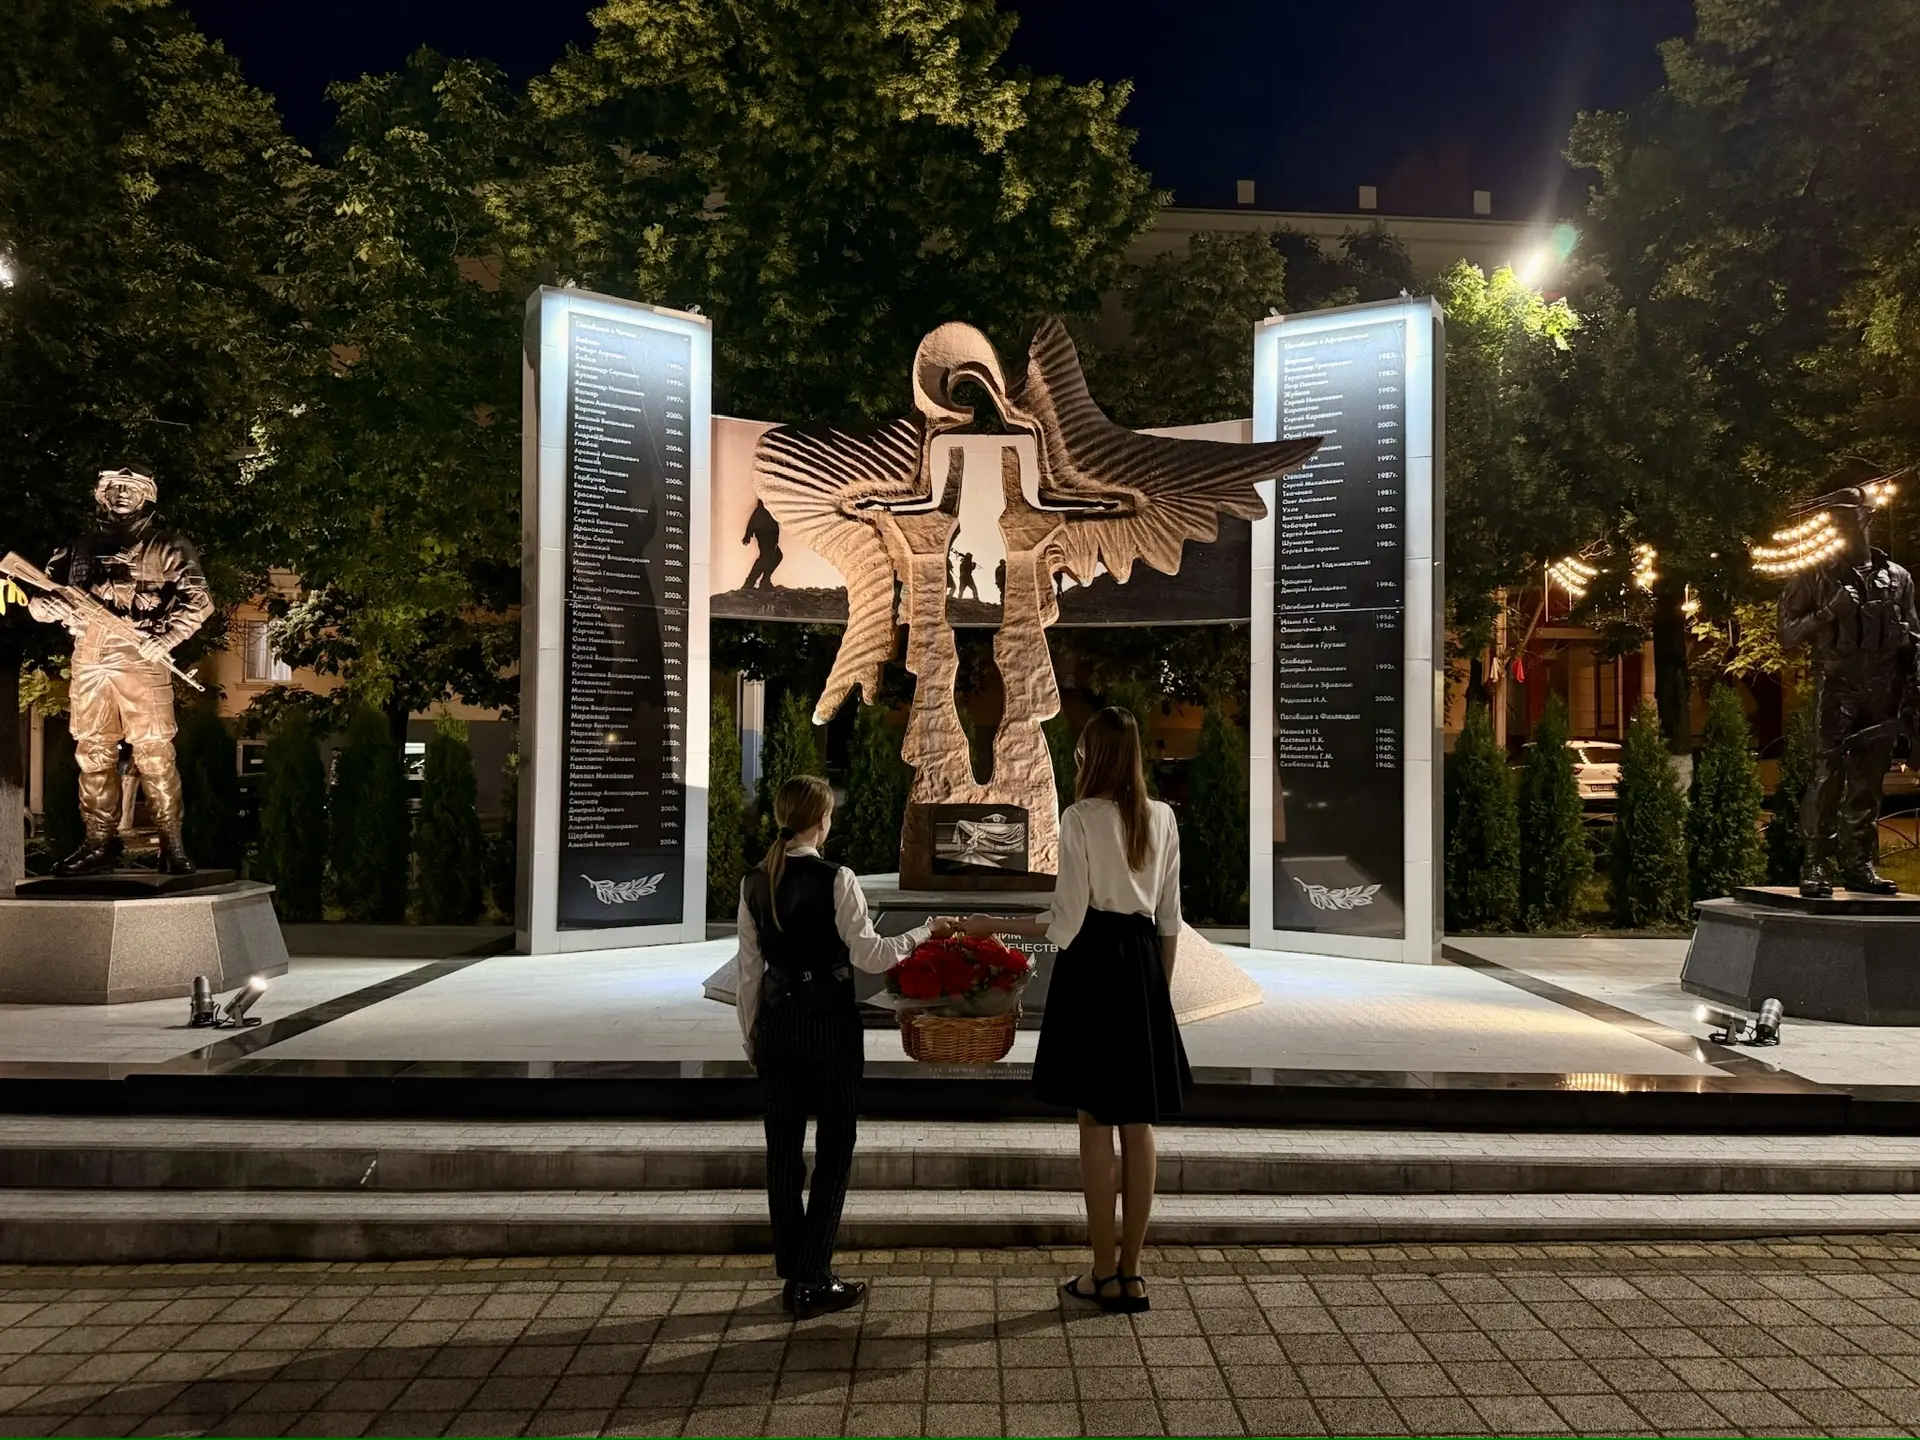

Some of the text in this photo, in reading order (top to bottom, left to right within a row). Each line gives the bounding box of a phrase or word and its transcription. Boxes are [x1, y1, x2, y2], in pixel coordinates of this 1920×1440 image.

[574, 380, 608, 391] Александр
[1283, 415, 1305, 423] Сергей
[1282, 481, 1304, 489] Сергей
[573, 551, 606, 560] Александр
